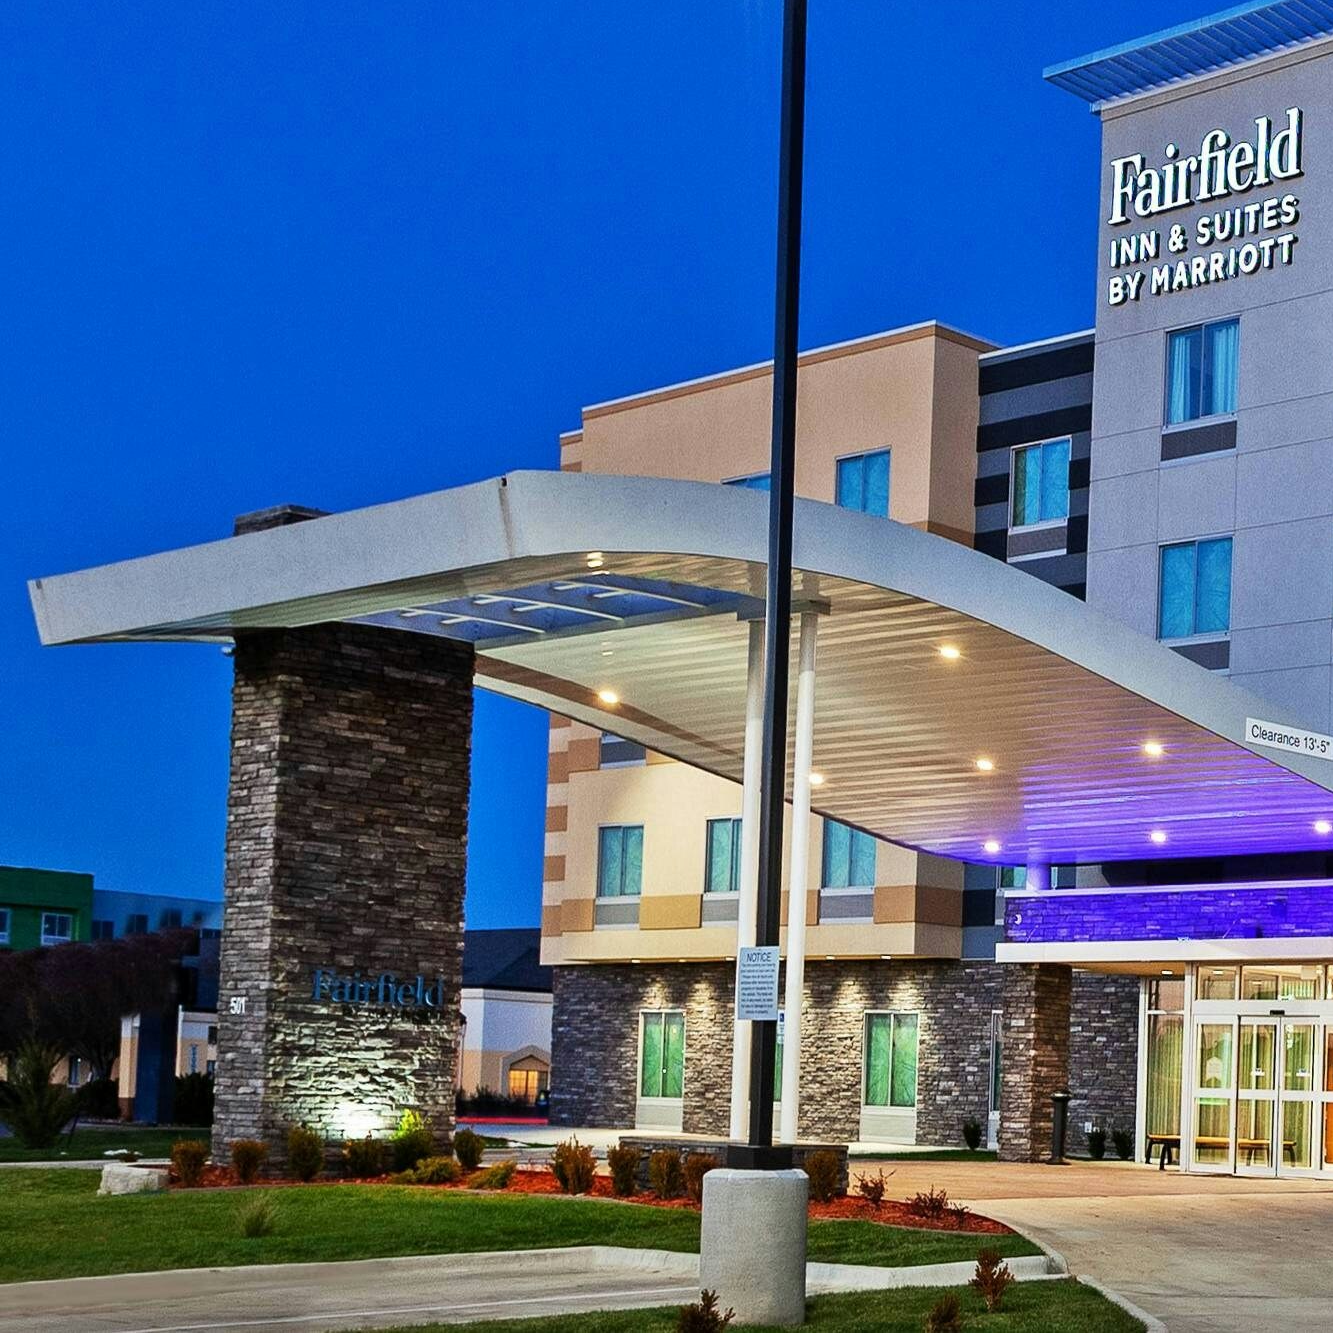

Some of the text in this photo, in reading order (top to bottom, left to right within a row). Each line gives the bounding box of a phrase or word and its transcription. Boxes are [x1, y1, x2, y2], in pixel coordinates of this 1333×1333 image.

[1108, 106, 1302, 225] Fairfield
[1110, 194, 1298, 267] INN & SUITES
[1108, 233, 1297, 305] BY MARRIOTT
[1251, 724, 1300, 748] Clearance
[746, 951, 772, 962] NOTICE
[229, 996, 247, 1015] 501
[312, 969, 444, 1007] Fairfield
